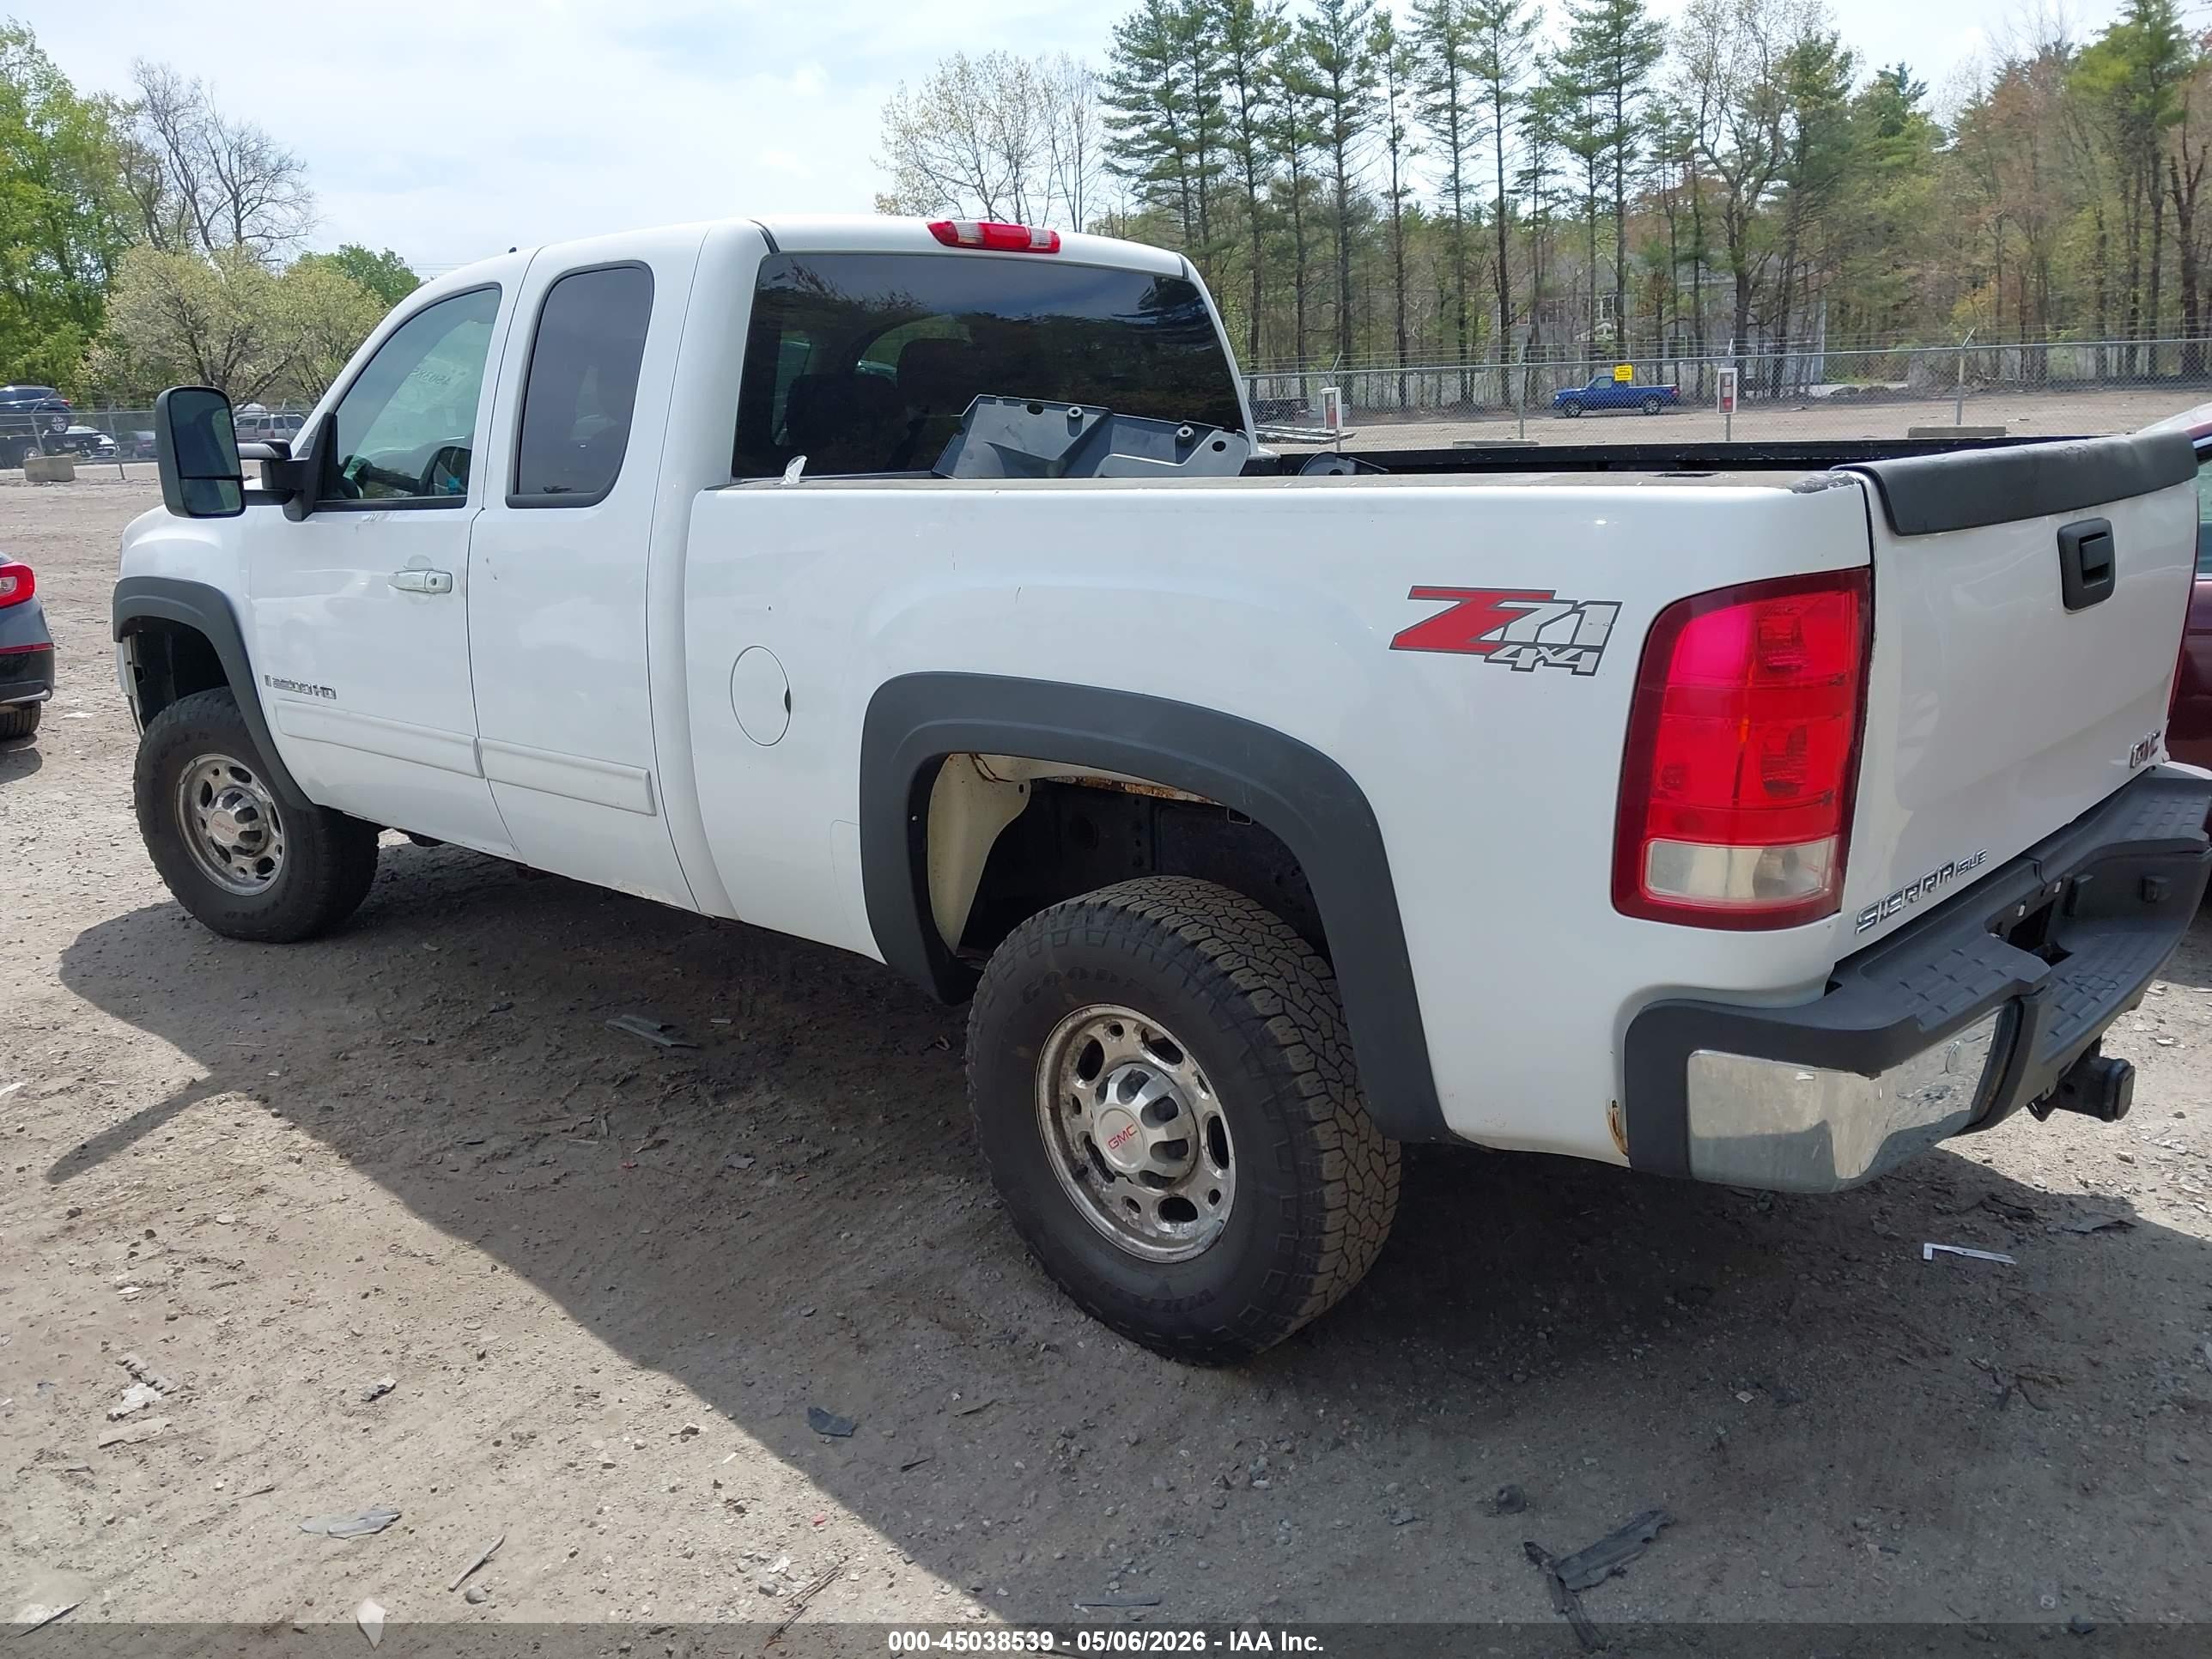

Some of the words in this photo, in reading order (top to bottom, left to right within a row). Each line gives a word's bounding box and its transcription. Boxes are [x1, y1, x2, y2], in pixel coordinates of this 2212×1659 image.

[1389, 586, 1623, 655] Z71
[1855, 859, 1955, 934] SIERRA
[1108, 1124, 1138, 1150] GMC
